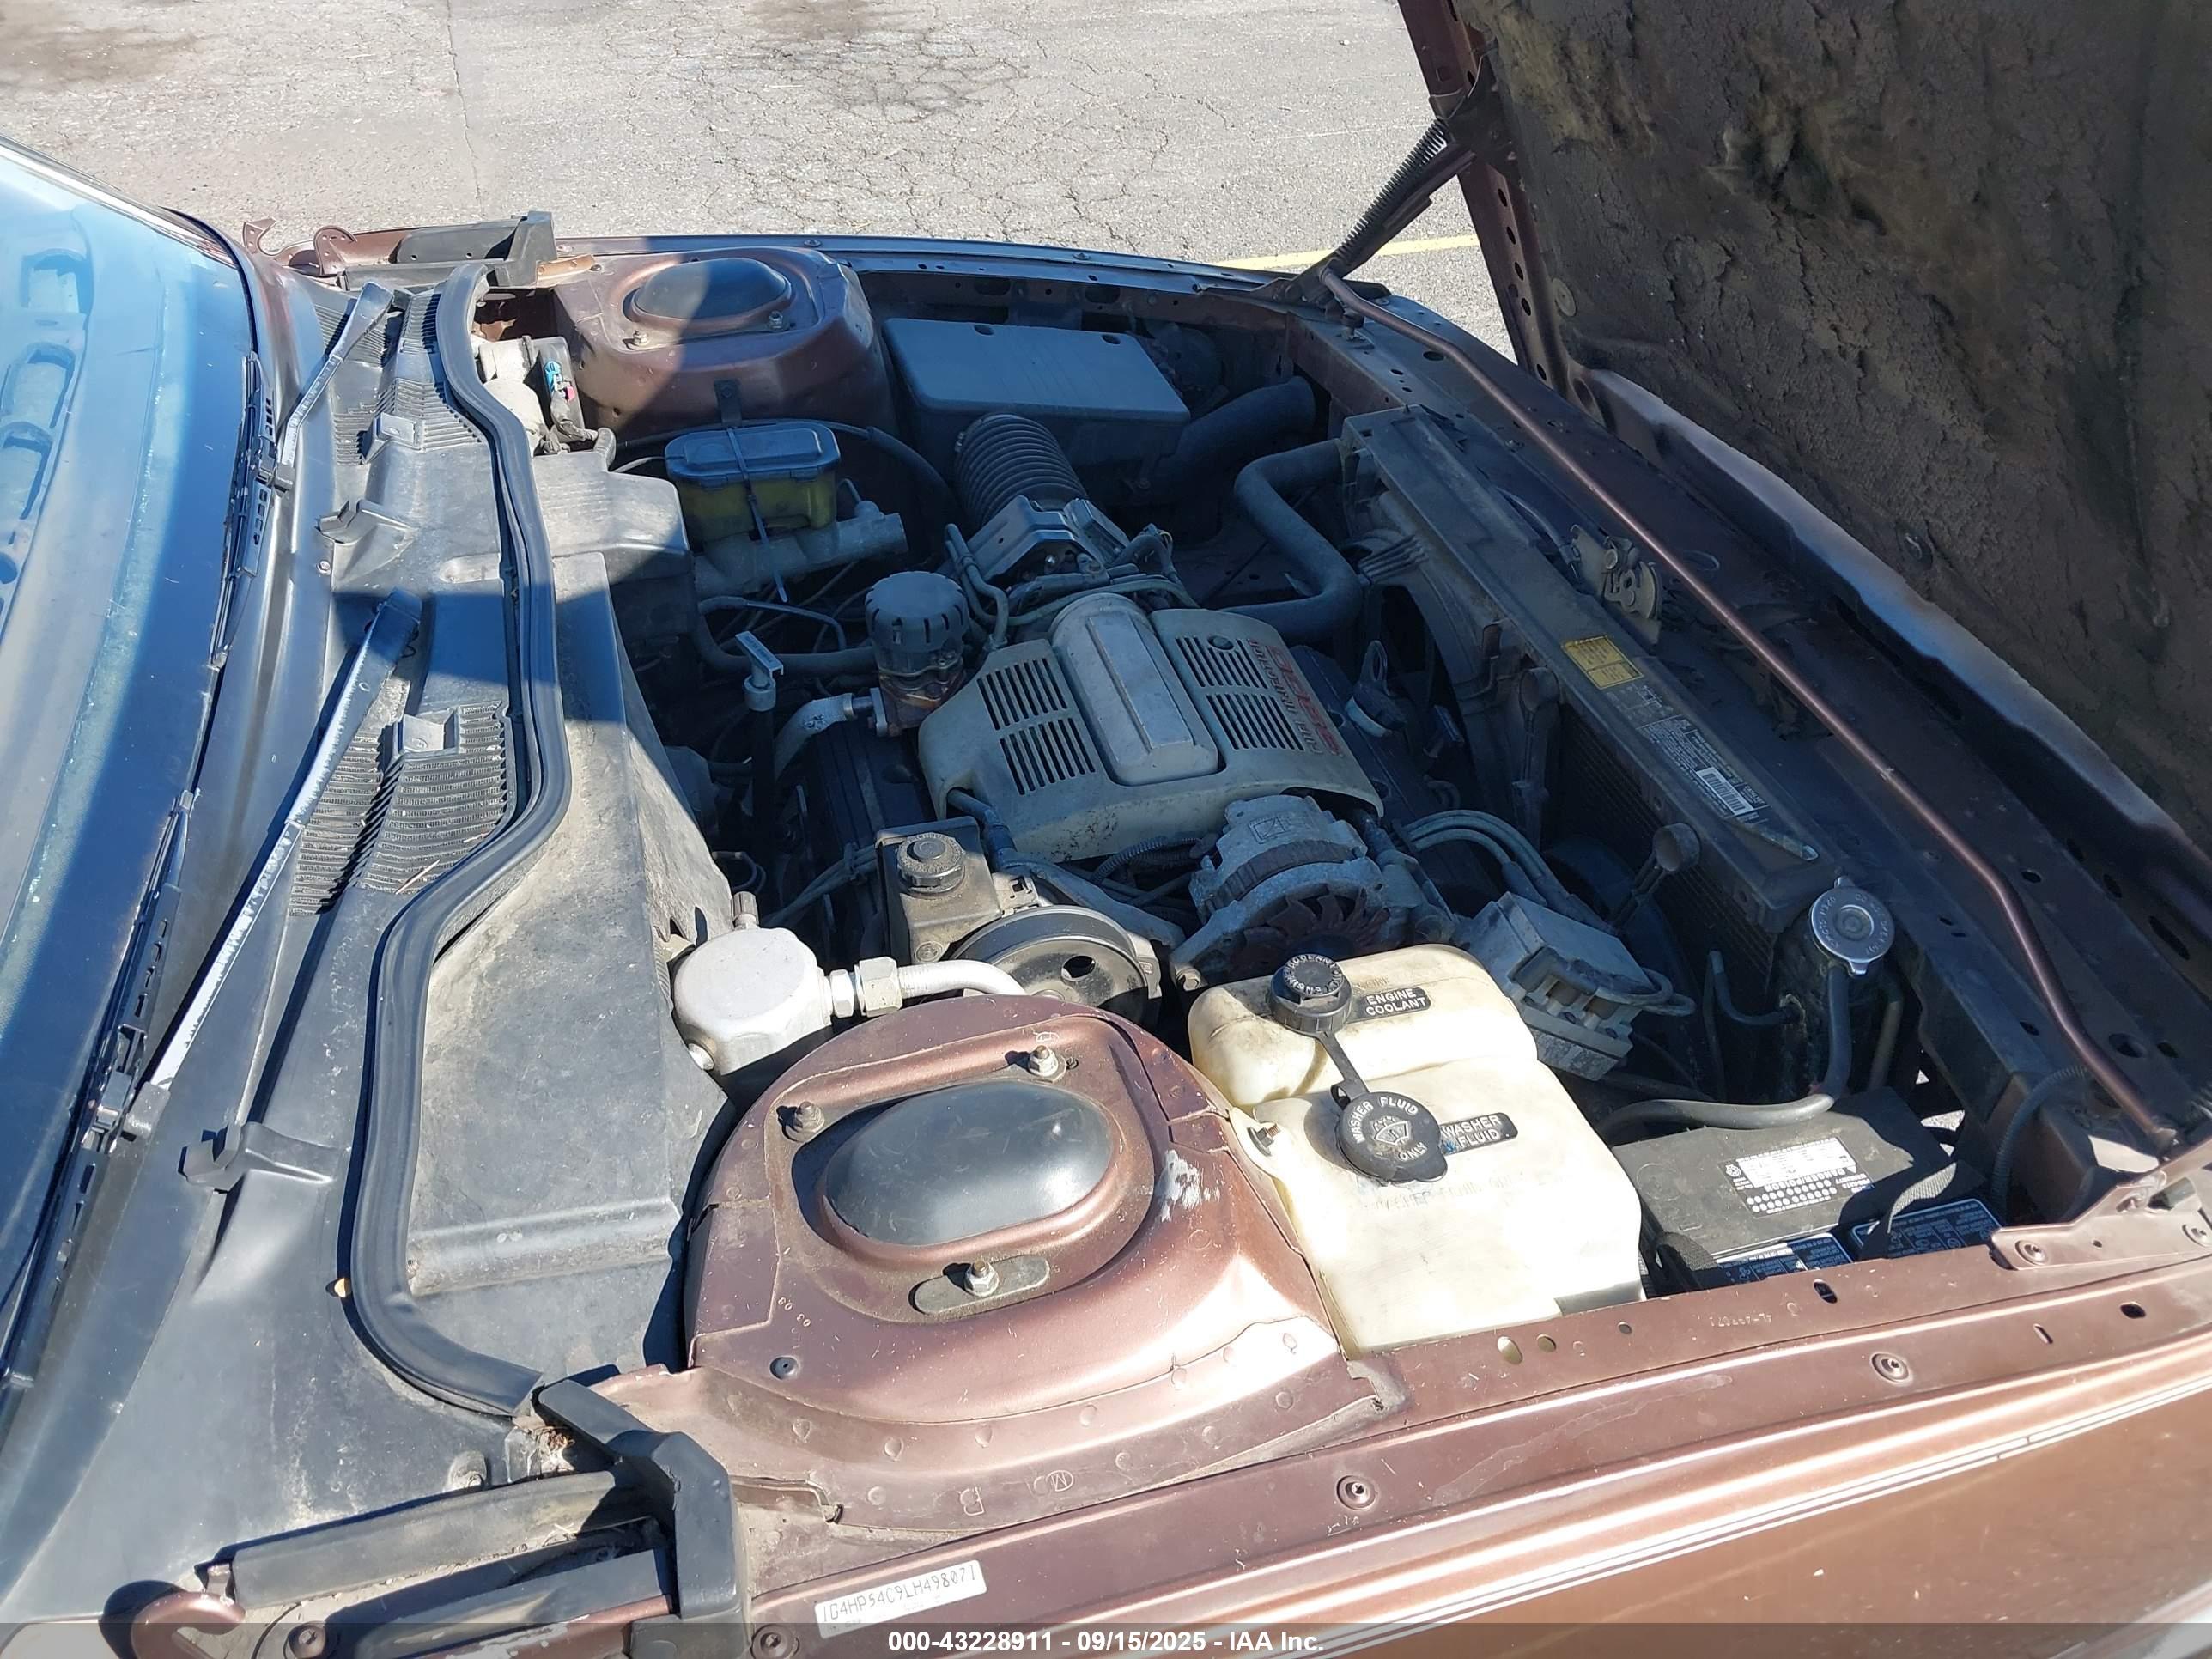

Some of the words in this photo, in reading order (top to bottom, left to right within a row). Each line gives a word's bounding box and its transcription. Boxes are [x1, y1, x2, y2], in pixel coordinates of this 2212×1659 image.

[1365, 997, 1426, 1017] COOLANT
[1366, 988, 1417, 1006] ENGINE
[1352, 1100, 1374, 1144] WASHER
[1379, 1096, 1419, 1115] FLUID
[1441, 1114, 1502, 1139] WASHER
[1458, 1128, 1500, 1148] FLUID
[1400, 1141, 1428, 1161] ONLY
[822, 1565, 976, 1622] 1G4HP54C9LH498071
